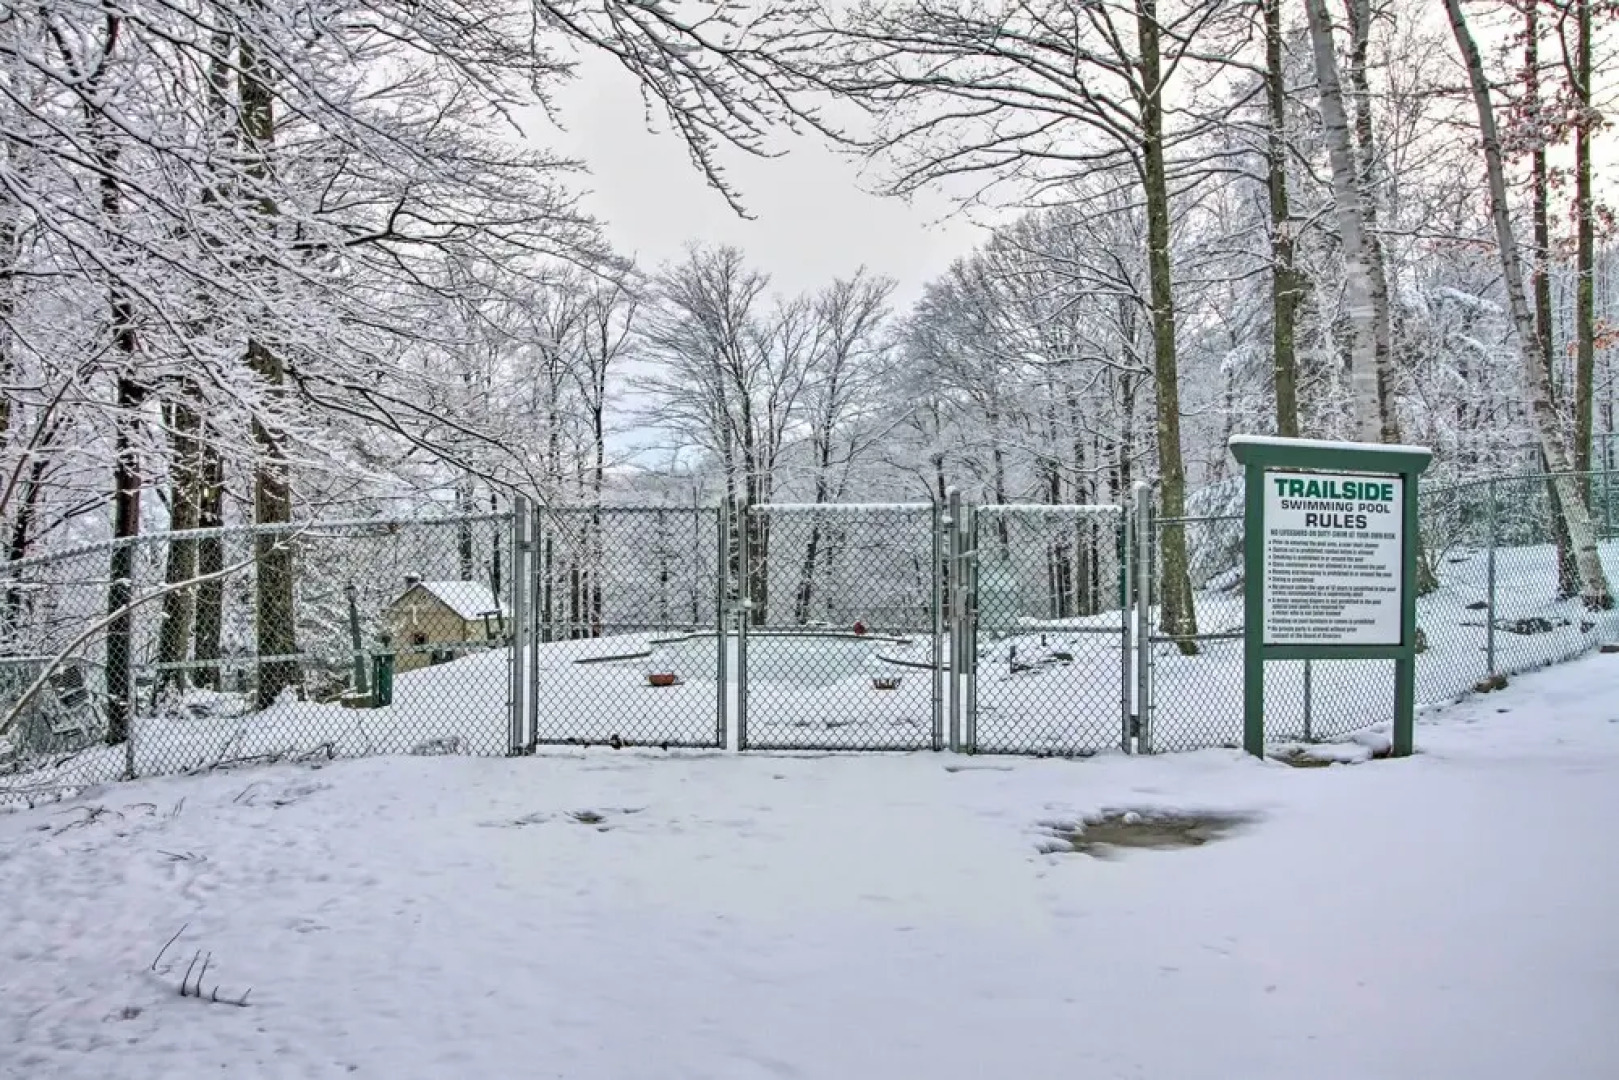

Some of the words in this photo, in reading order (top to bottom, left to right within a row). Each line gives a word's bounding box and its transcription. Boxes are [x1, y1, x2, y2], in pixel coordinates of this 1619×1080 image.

[1274, 478, 1393, 501] TRAILSIDE
[1281, 499, 1354, 512] SWIMMING
[1358, 503, 1391, 513] POOL
[1305, 513, 1367, 529] RULES
